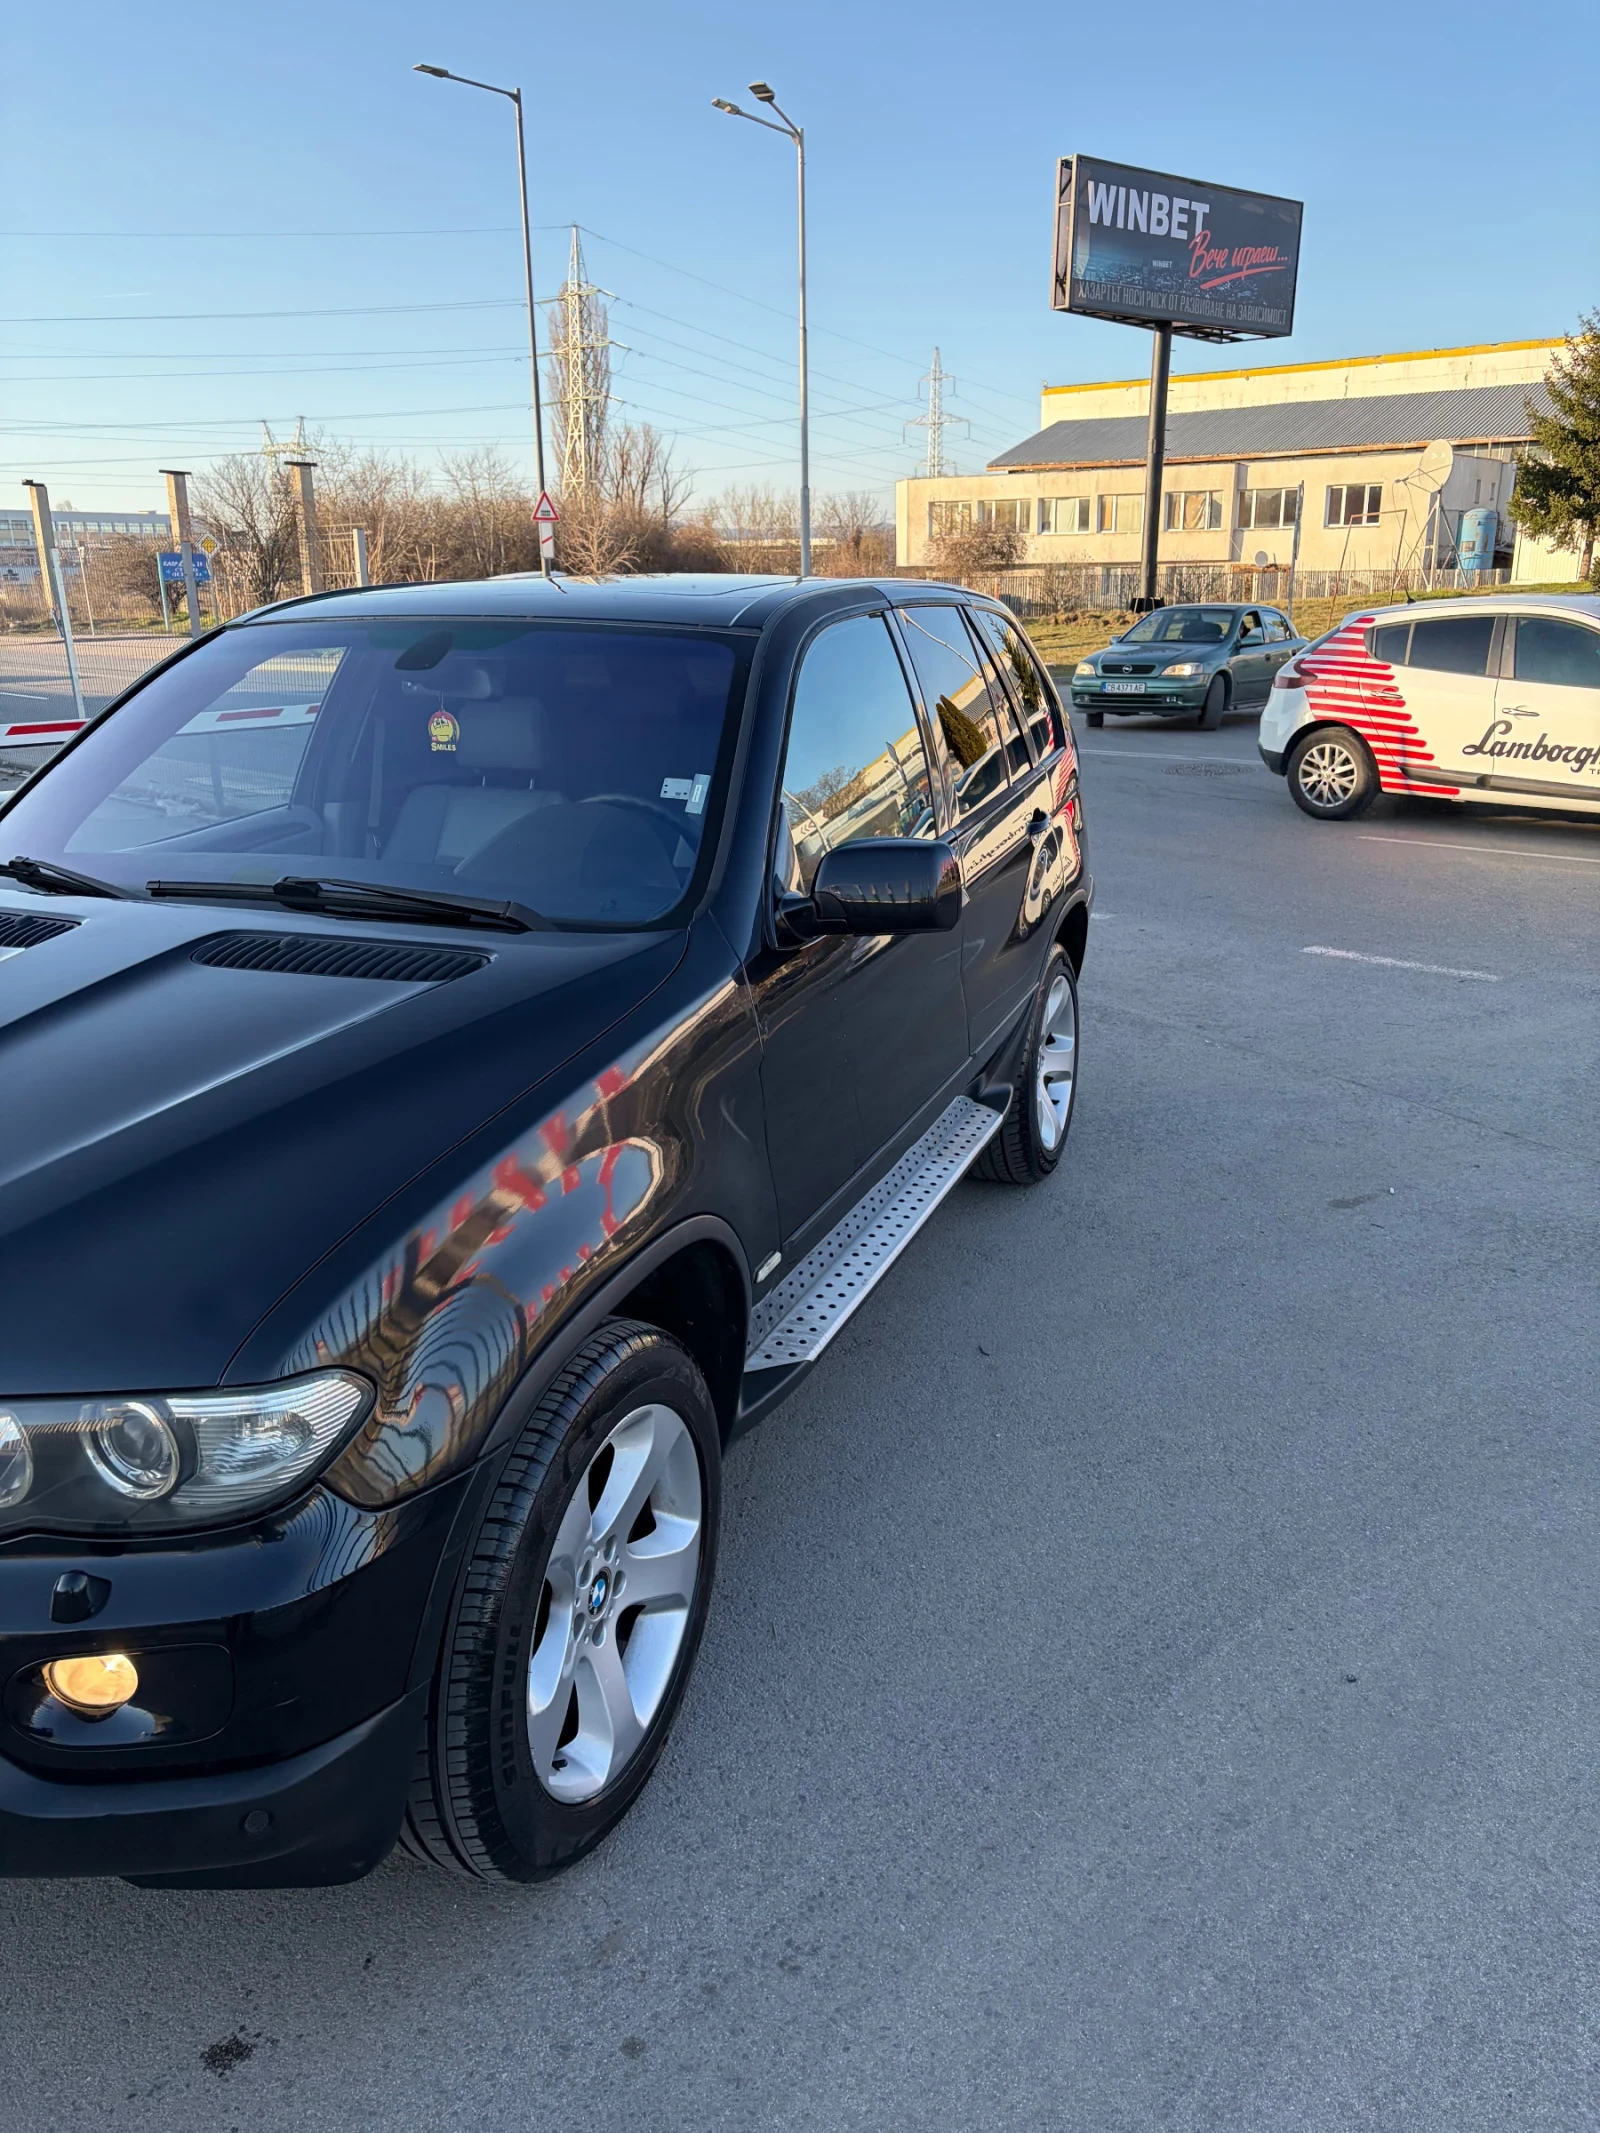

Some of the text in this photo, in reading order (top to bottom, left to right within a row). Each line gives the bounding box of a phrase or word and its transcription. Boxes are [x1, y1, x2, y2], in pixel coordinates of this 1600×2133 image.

[1087, 180, 1210, 242] WINBET
[1152, 260, 1173, 269] WINBET
[1188, 230, 1229, 278] Вече
[1078, 280, 1287, 326] ХАЗАРТЪТ НОСИ РИСК ОТ РАЗВИВАНЕ НА ЗАВИСИМОСТ
